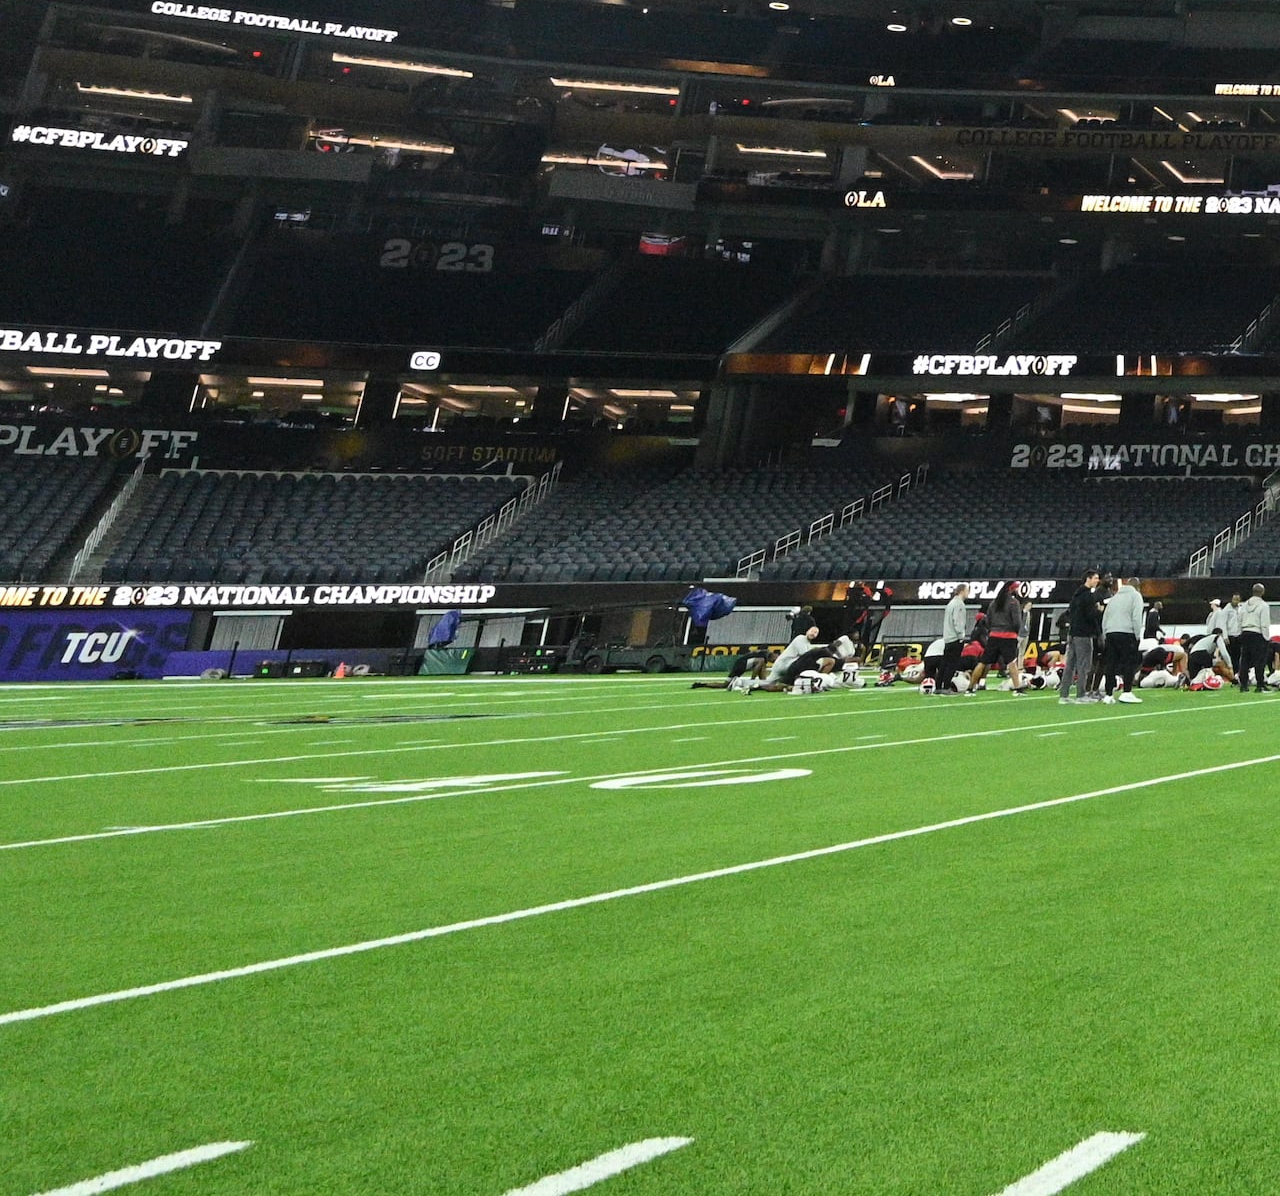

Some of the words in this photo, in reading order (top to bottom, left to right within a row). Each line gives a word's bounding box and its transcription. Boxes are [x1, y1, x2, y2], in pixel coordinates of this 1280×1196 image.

[151, 1, 232, 22] COLLEGE
[233, 11, 322, 33] FOOTBALL
[323, 23, 398, 42] PLAYOFF
[12, 125, 188, 157] #CFBPLAYOFF
[1081, 195, 1153, 212] WELCOME
[1154, 196, 1173, 212] TO
[1175, 196, 1203, 212] THE
[86, 335, 222, 360] PLAYOFF
[912, 355, 1077, 375] #CFBPLAYOFF
[1090, 444, 1246, 469] NATIONAL
[40, 586, 68, 605] TO
[69, 586, 110, 605] THE
[181, 586, 310, 605] NATIONAL
[313, 584, 496, 604] CHAMPIONSHIP
[61, 630, 136, 664] TCU
